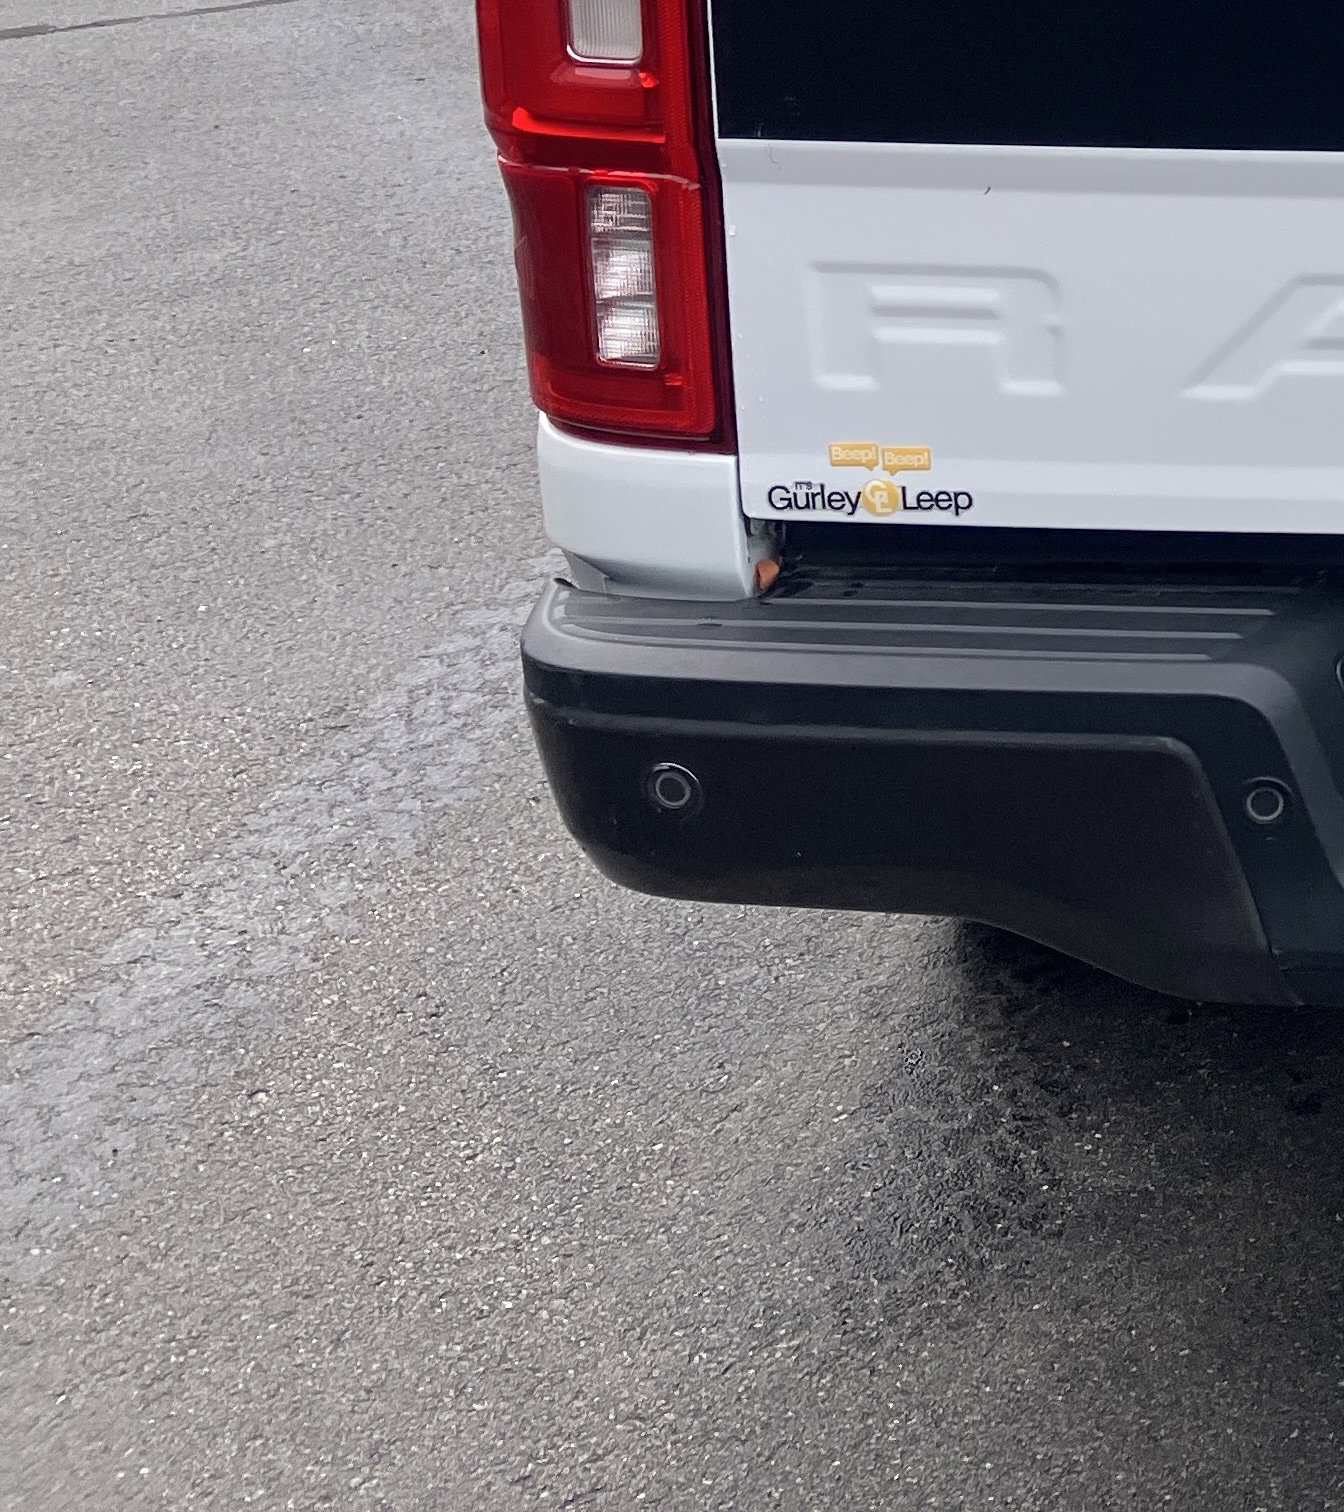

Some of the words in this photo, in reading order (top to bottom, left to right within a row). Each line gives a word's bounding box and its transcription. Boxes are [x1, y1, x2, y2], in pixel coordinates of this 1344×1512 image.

[830, 445, 877, 462] Beep!
[883, 451, 929, 468] Beep!
[768, 484, 862, 516] Gurley
[901, 486, 973, 516] Leep
